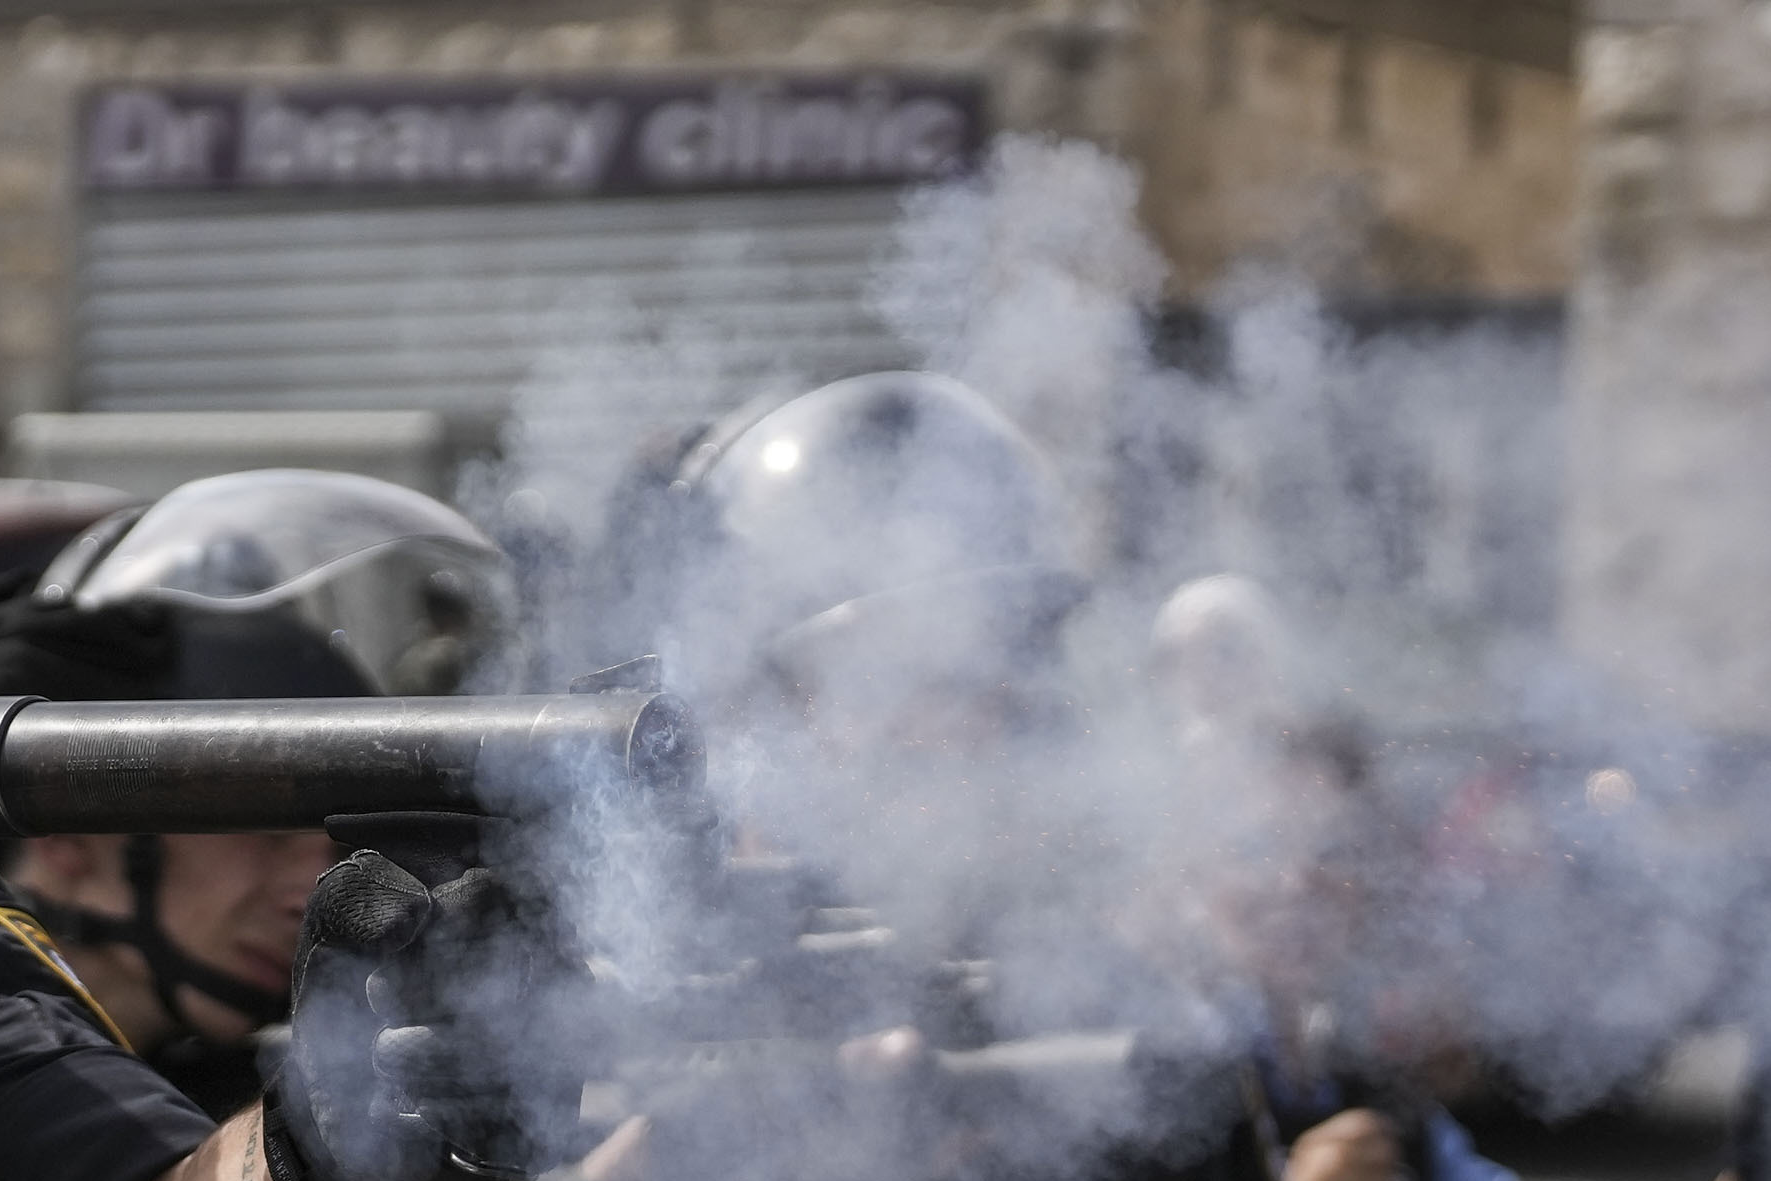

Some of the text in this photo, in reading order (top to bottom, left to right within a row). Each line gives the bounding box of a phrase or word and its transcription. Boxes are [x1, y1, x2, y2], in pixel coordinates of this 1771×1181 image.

[94, 77, 963, 184] Dr beauty clinic
